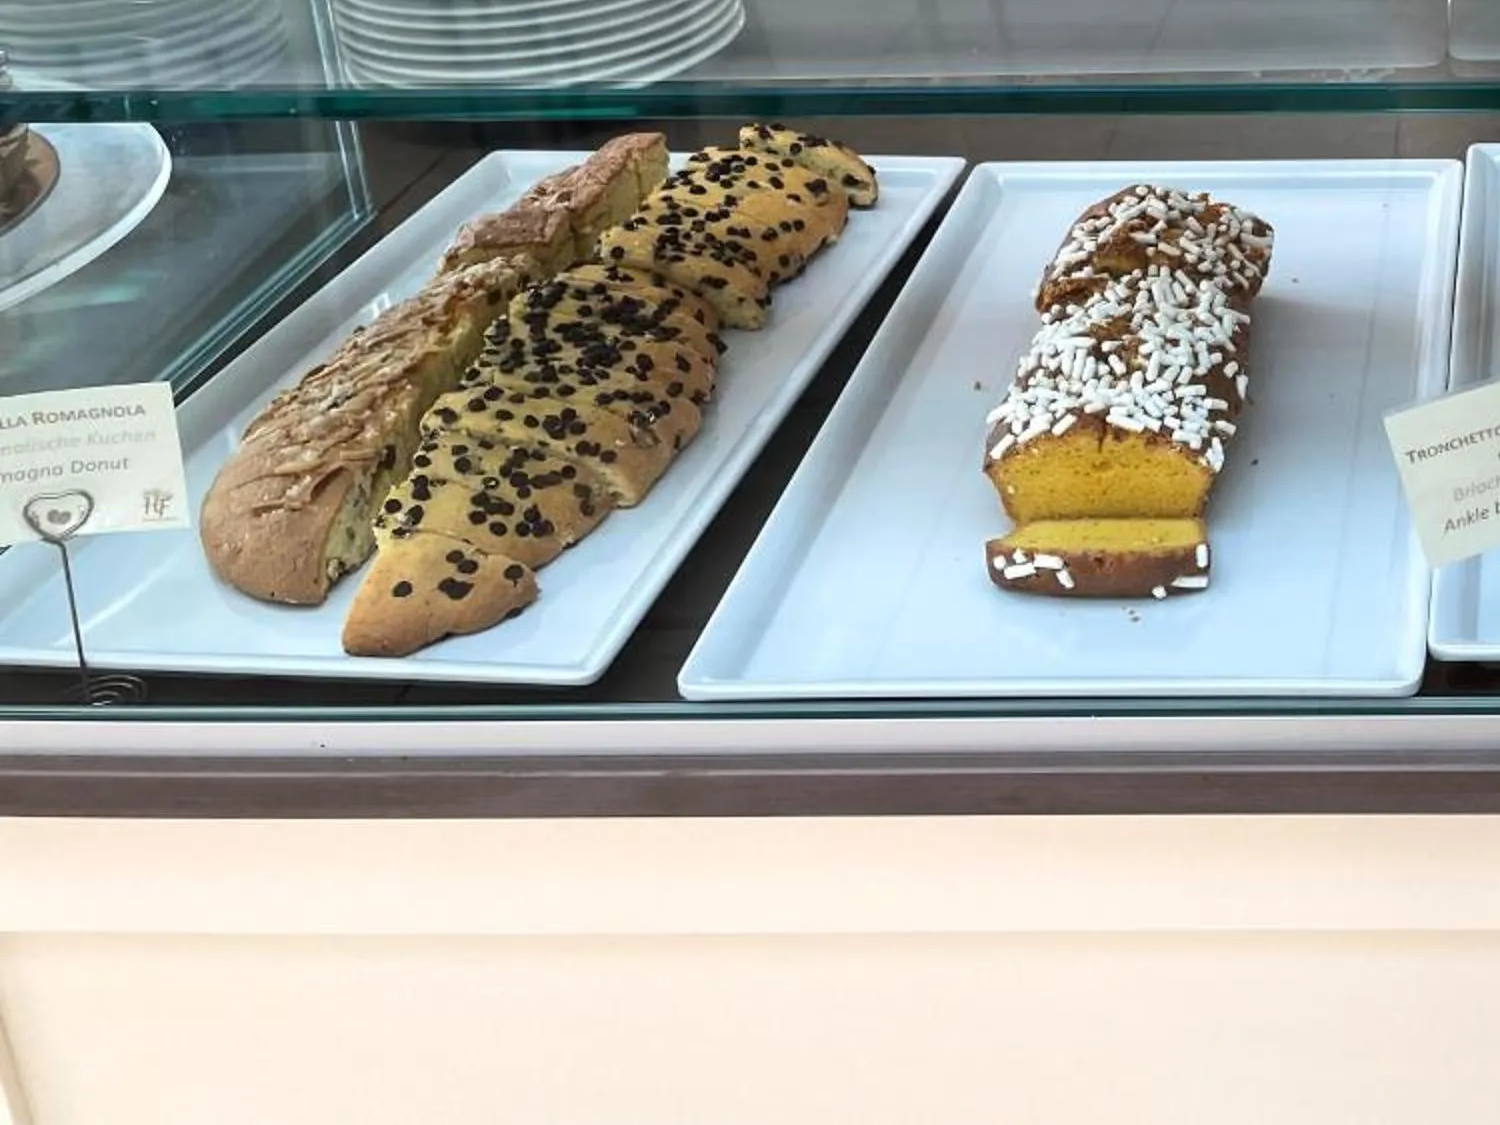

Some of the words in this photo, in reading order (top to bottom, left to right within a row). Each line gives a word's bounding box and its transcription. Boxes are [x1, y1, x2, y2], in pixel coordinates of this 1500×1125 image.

[31, 404, 147, 425] ROMAGNOLA
[71, 458, 129, 474] Donut
[1443, 506, 1490, 535] Ankle
